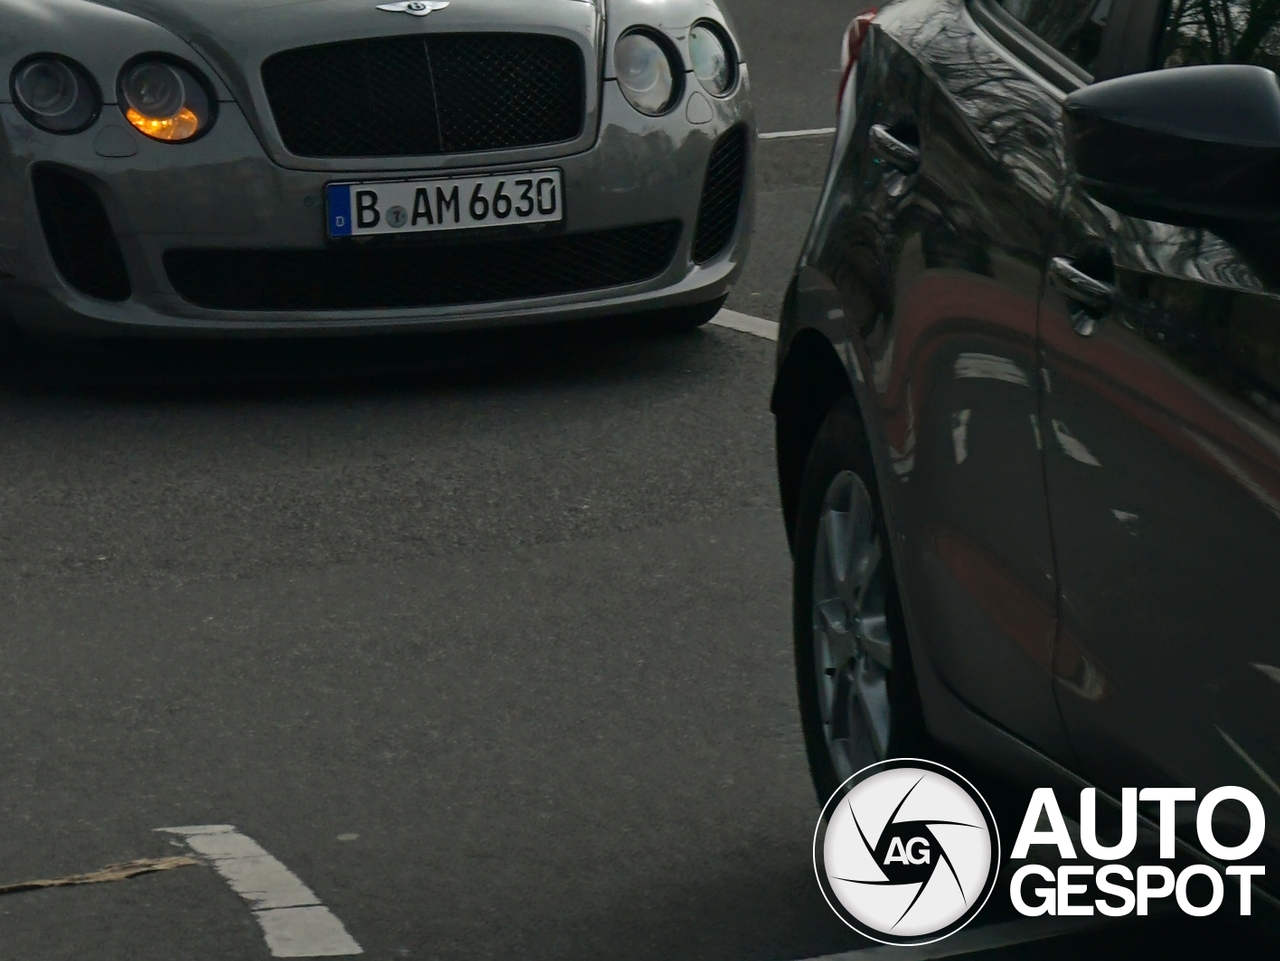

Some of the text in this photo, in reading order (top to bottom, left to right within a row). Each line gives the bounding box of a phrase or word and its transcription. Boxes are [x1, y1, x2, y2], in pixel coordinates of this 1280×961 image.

[356, 177, 557, 228] B AM 6630
